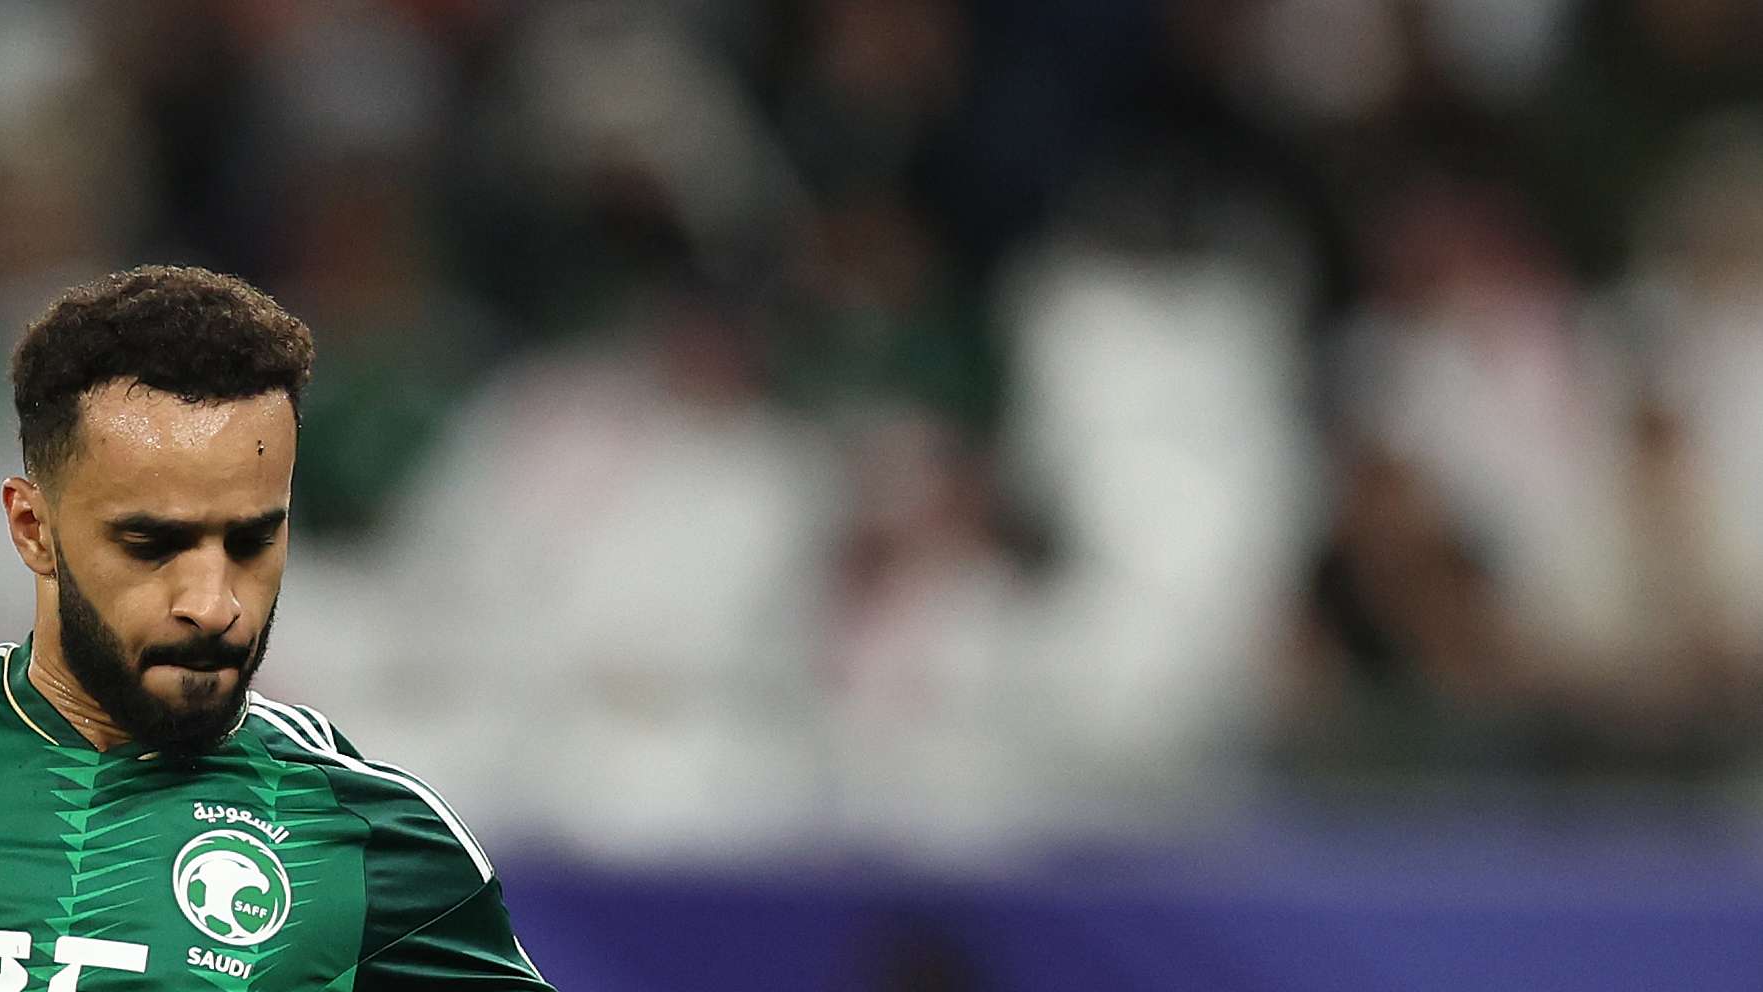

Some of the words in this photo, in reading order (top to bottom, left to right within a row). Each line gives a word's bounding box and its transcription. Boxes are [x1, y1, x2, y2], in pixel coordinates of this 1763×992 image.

[193, 801, 290, 844] السعودية
[234, 900, 268, 919] SAFF
[186, 947, 253, 979] SAUDI
